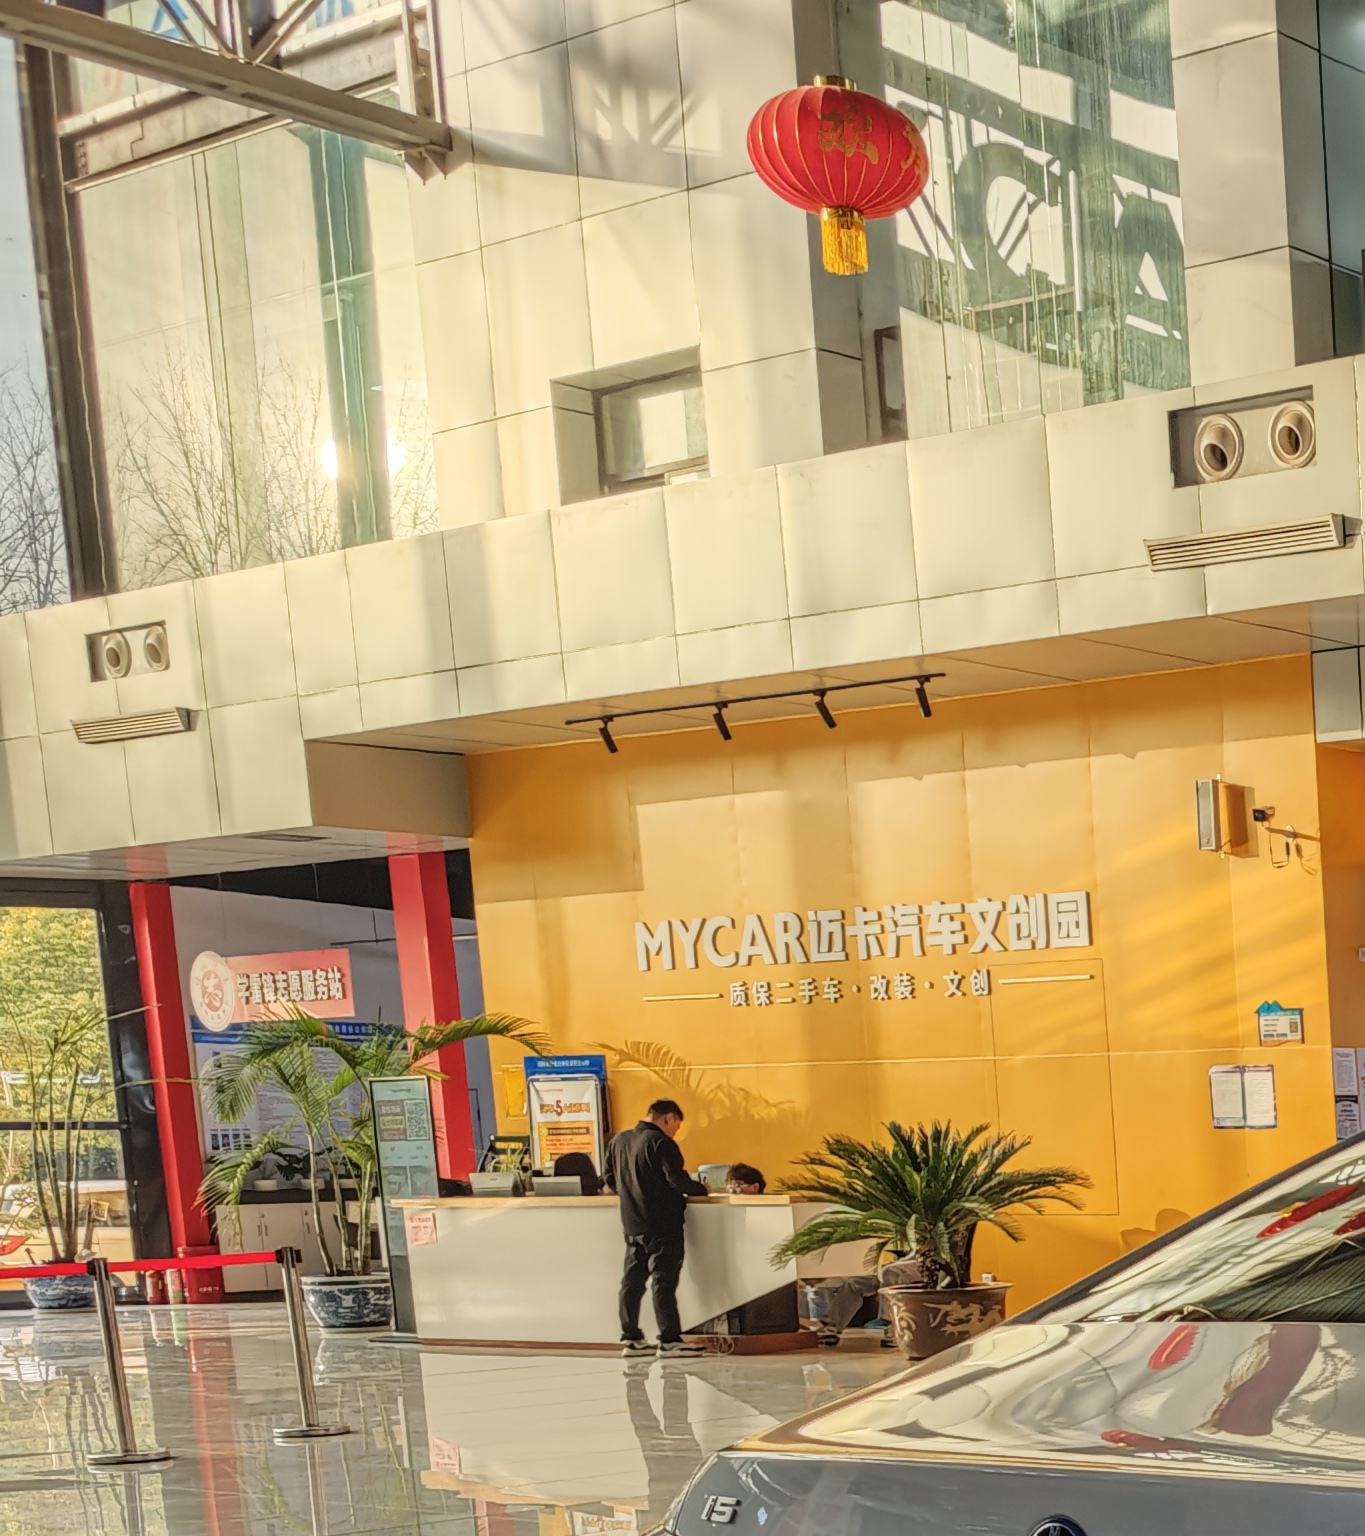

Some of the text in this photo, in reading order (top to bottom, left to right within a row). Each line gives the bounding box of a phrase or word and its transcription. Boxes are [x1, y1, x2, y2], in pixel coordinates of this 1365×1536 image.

[635, 891, 1094, 973] MYCAR迈卡汽车文创园
[236, 965, 344, 1005] 学雷锋志愿服务站
[701, 1494, 741, 1524] i5
